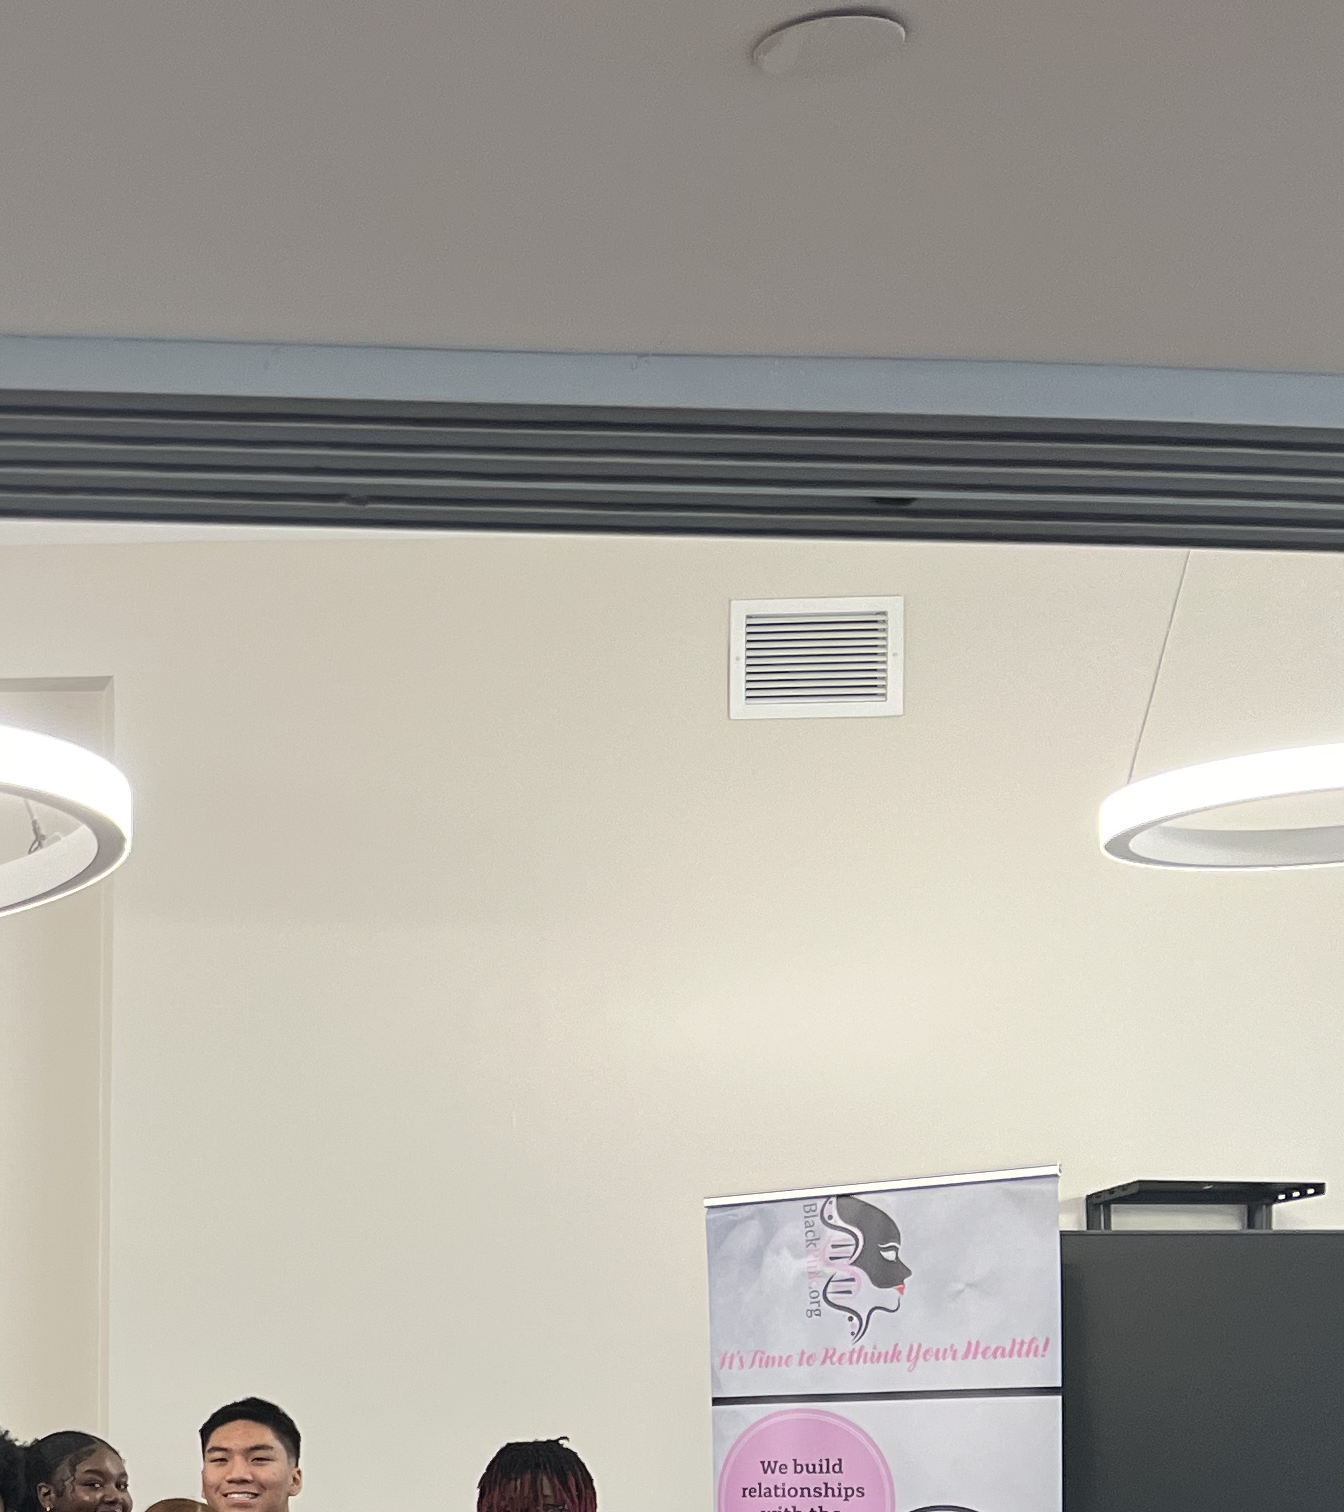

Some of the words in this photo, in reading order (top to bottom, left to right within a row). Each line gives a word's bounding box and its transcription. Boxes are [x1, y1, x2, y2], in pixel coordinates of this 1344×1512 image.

[720, 1350, 744, 1370] It's
[748, 1350, 792, 1369] Time
[798, 1350, 816, 1367] to
[820, 1341, 902, 1366] Rethink
[906, 1343, 957, 1372] Your
[962, 1336, 1050, 1360] Health!
[760, 1461, 787, 1474] We
[792, 1458, 843, 1474] build
[742, 1482, 864, 1501] relationships
